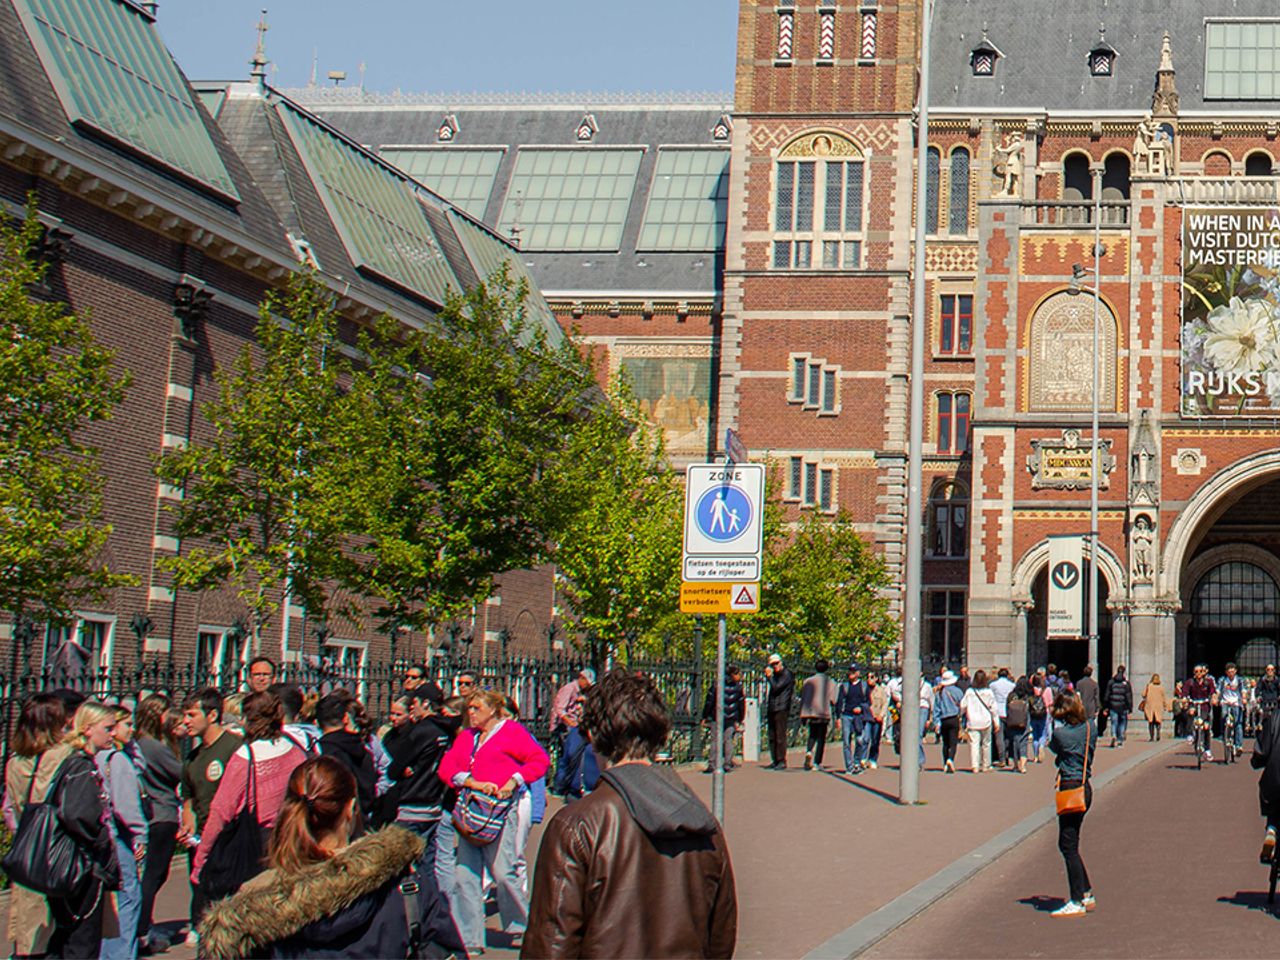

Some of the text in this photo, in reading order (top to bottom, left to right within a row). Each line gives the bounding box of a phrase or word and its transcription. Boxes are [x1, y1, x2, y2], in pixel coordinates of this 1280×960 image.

[1189, 214, 1241, 231] WHEN
[1247, 214, 1264, 231] IN
[1189, 232, 1233, 248] VISIT
[709, 471, 742, 481] ZONE
[715, 560, 756, 568] toegestaan
[683, 598, 720, 606] verboden
